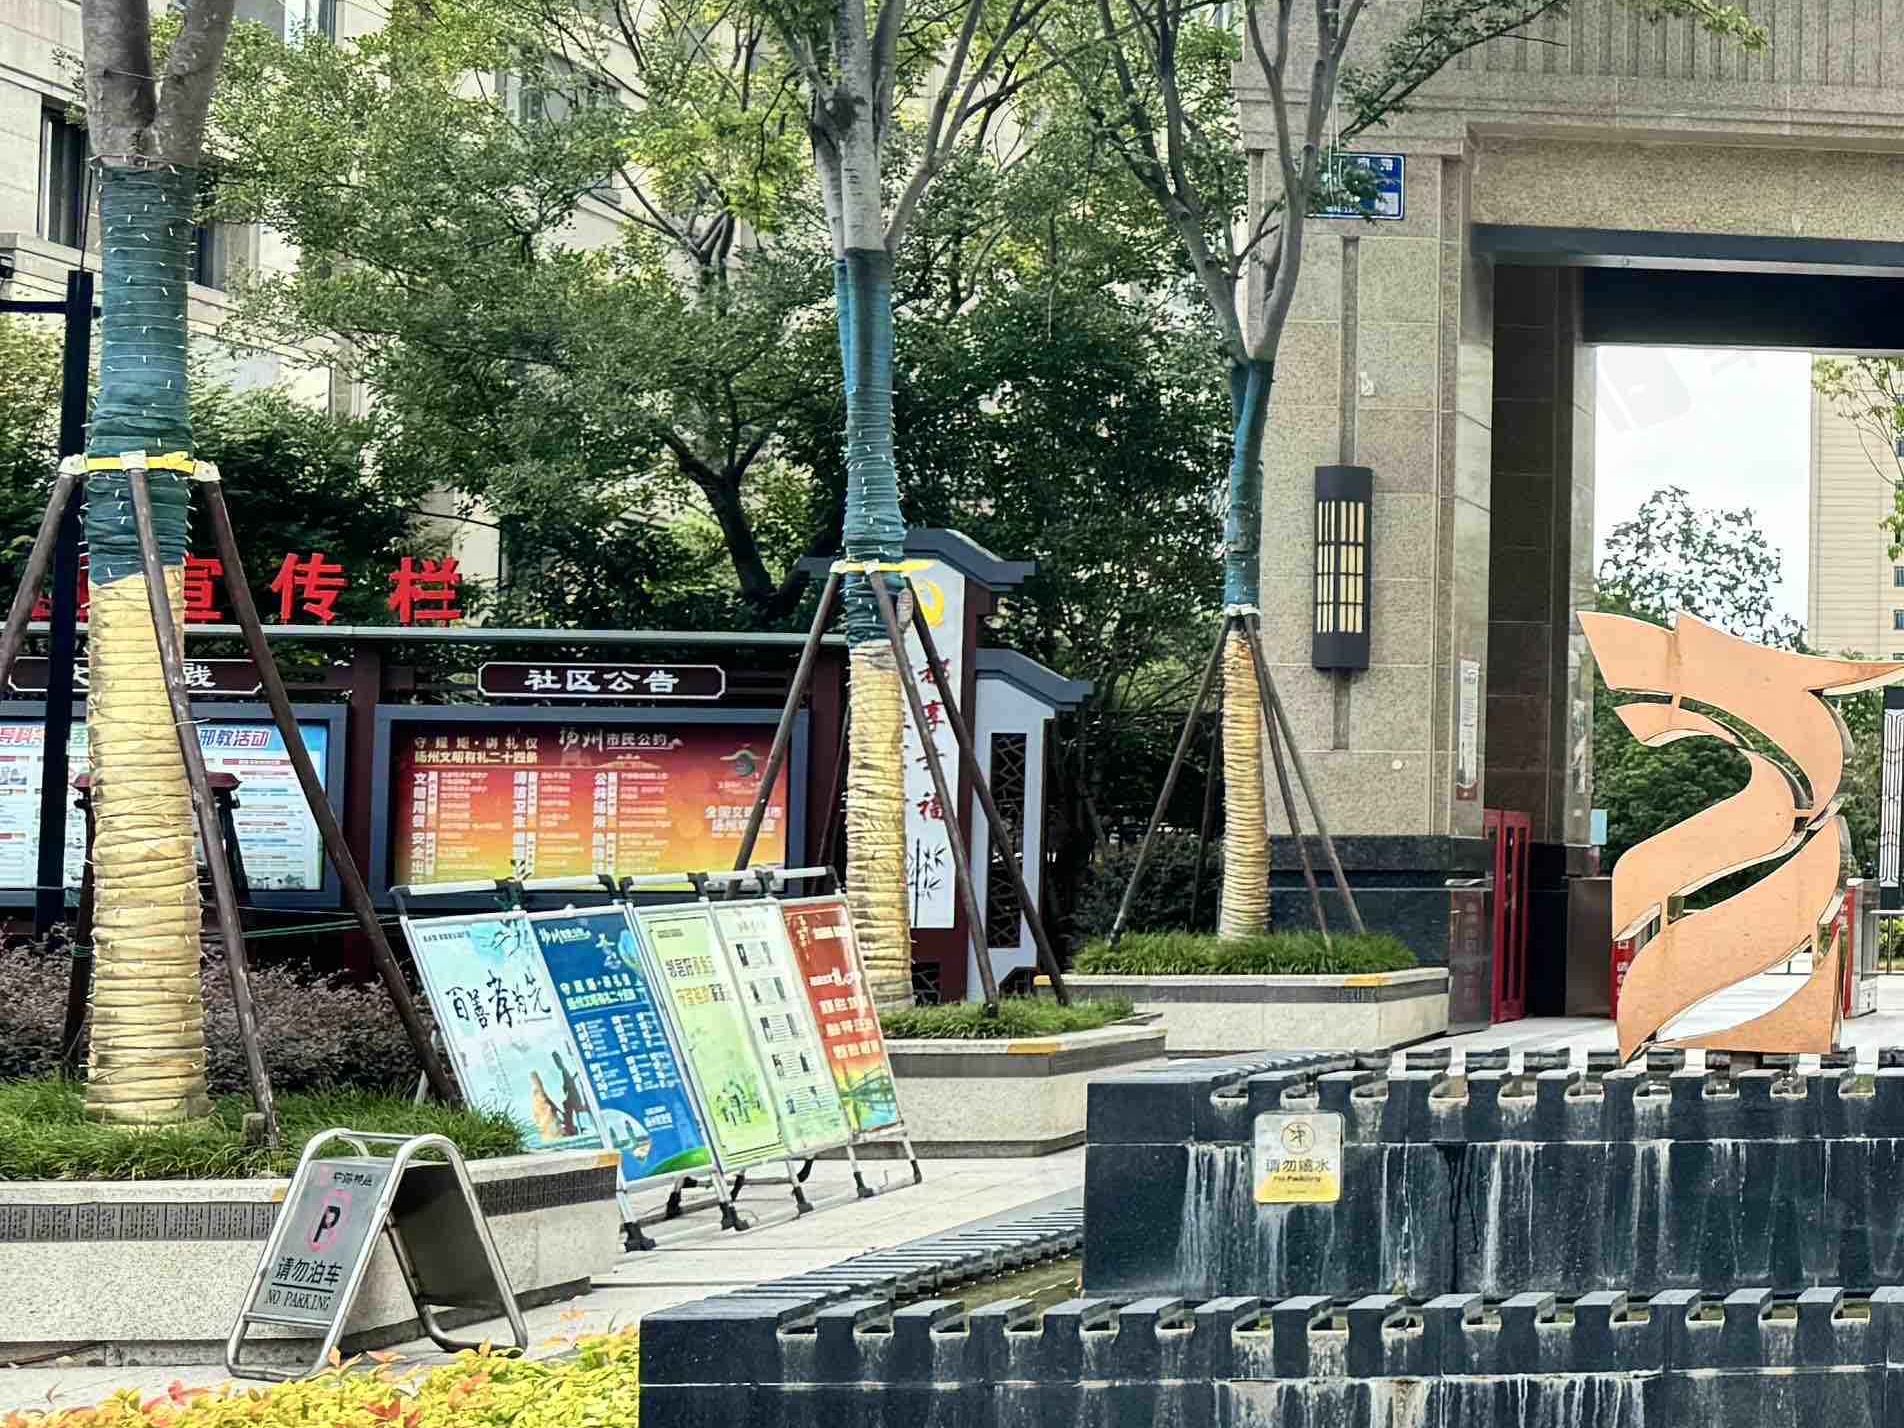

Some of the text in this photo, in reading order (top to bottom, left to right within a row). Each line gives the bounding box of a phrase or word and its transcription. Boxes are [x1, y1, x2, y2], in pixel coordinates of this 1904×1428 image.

[523, 668, 680, 693] 社区公告
[313, 1205, 341, 1243] P
[274, 1256, 343, 1286] 请勿泊车
[264, 1289, 333, 1311] NO PARKING
